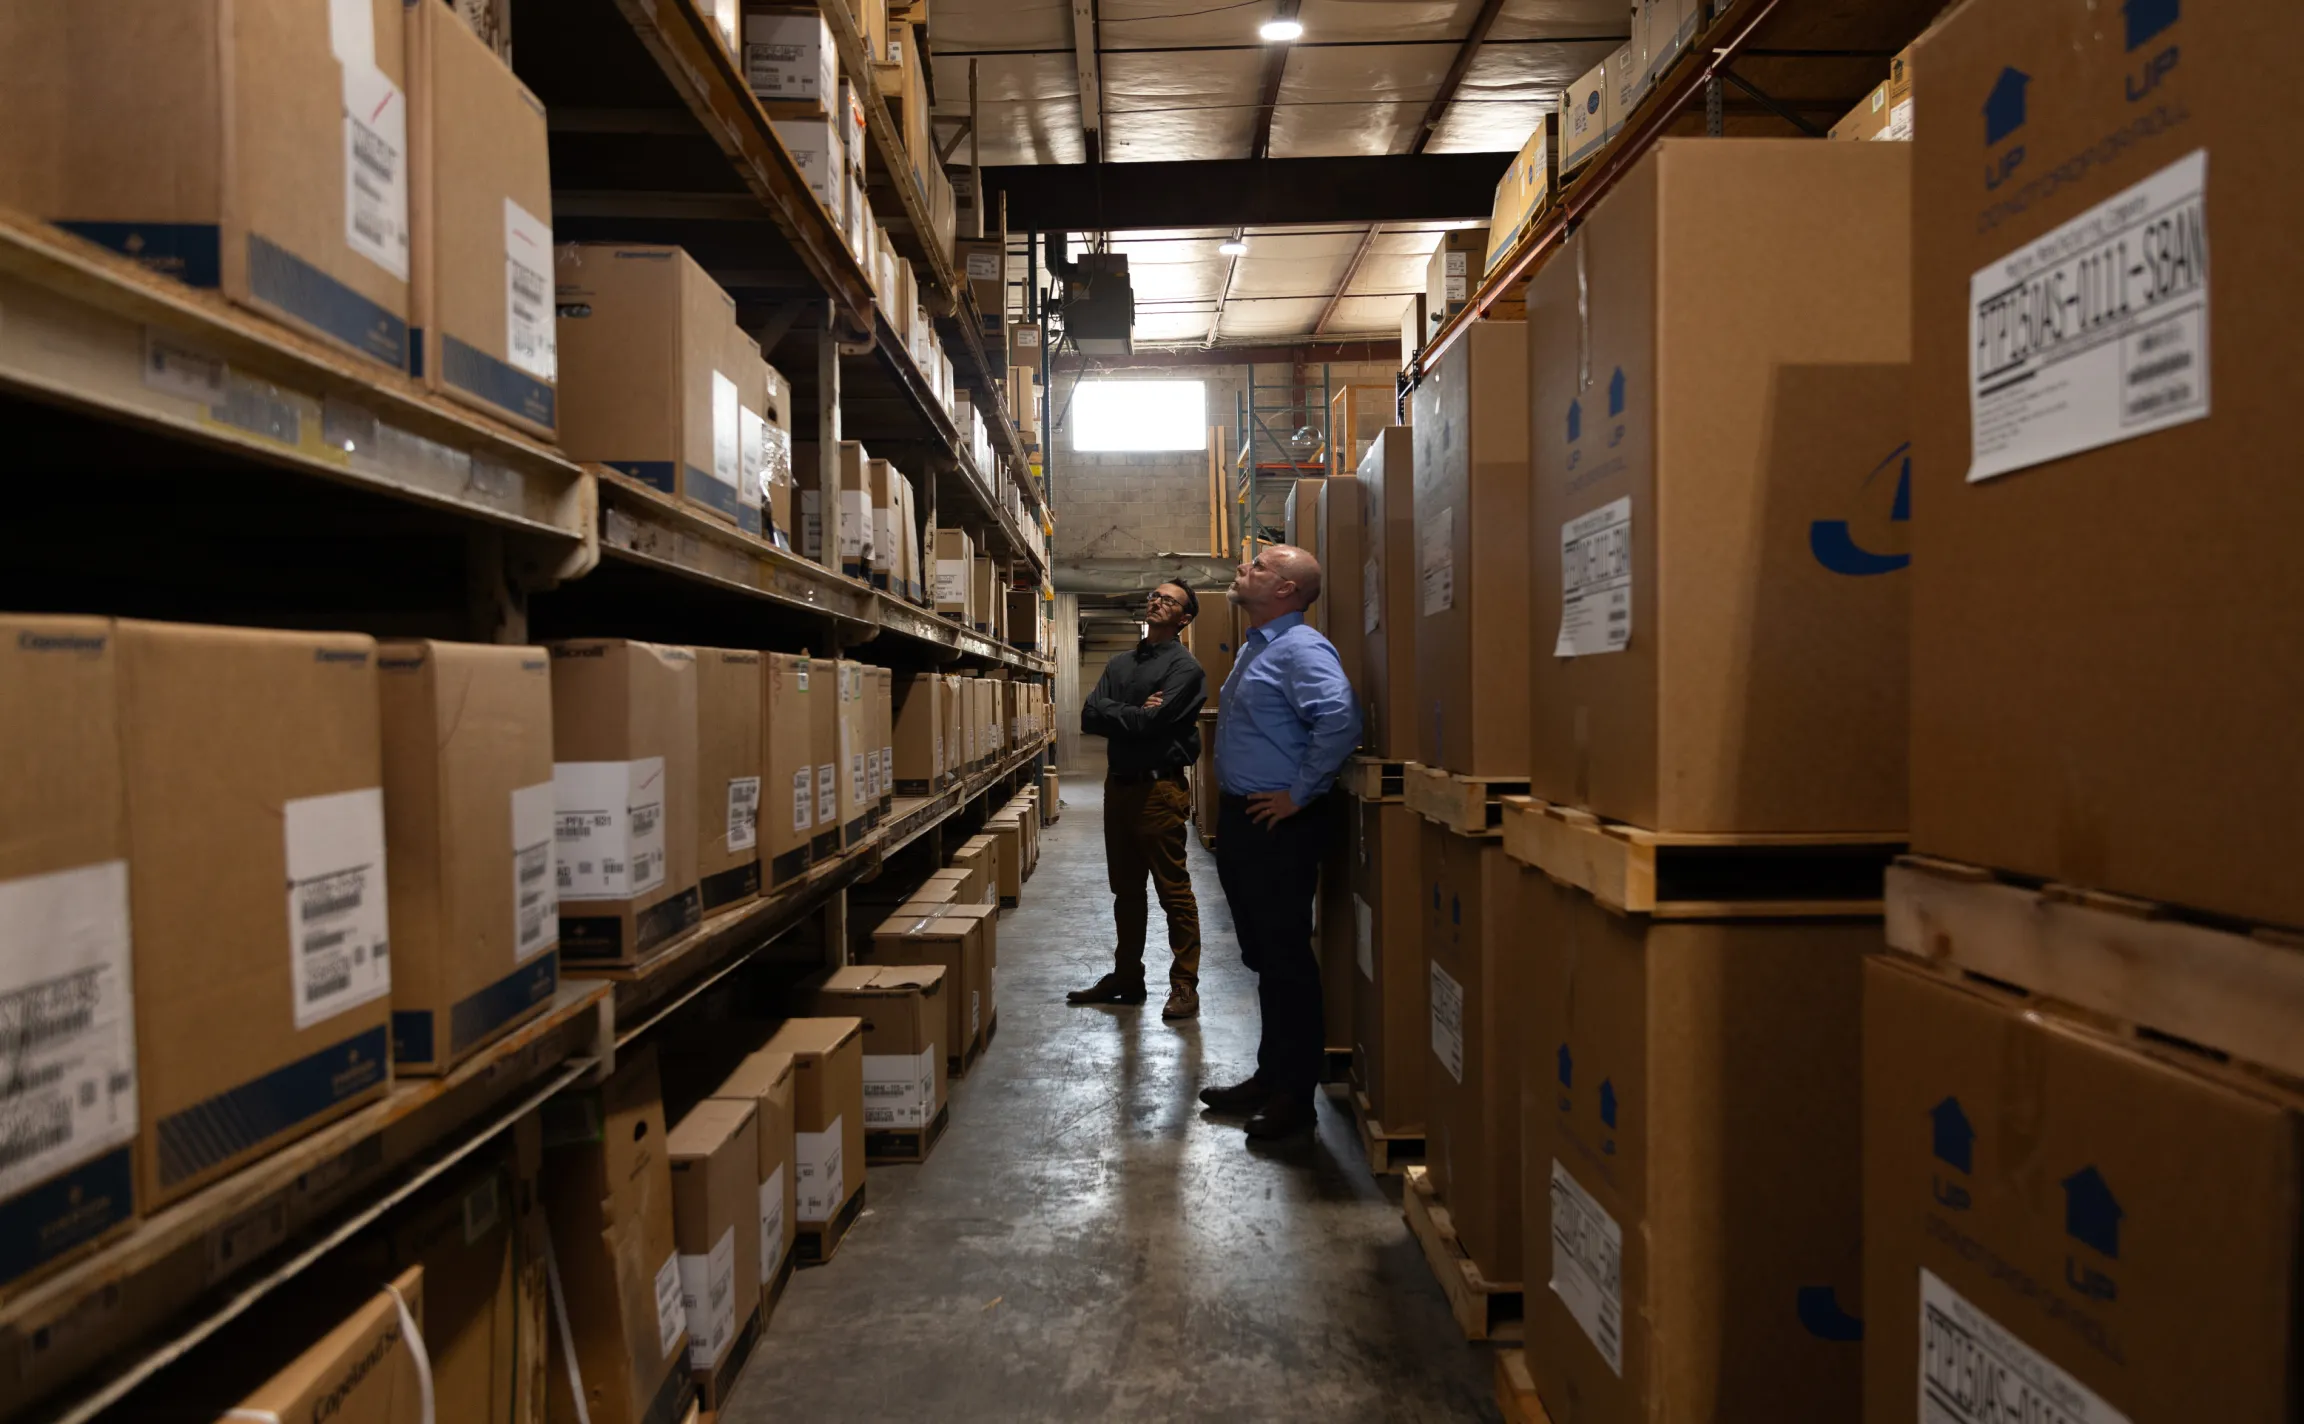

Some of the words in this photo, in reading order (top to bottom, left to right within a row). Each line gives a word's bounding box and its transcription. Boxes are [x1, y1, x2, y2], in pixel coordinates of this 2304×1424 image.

[2125, 45, 2180, 103] UP
[1984, 145, 2027, 192] UP
[1932, 1171, 1973, 1212] UP
[2064, 1252, 2118, 1303] UP
